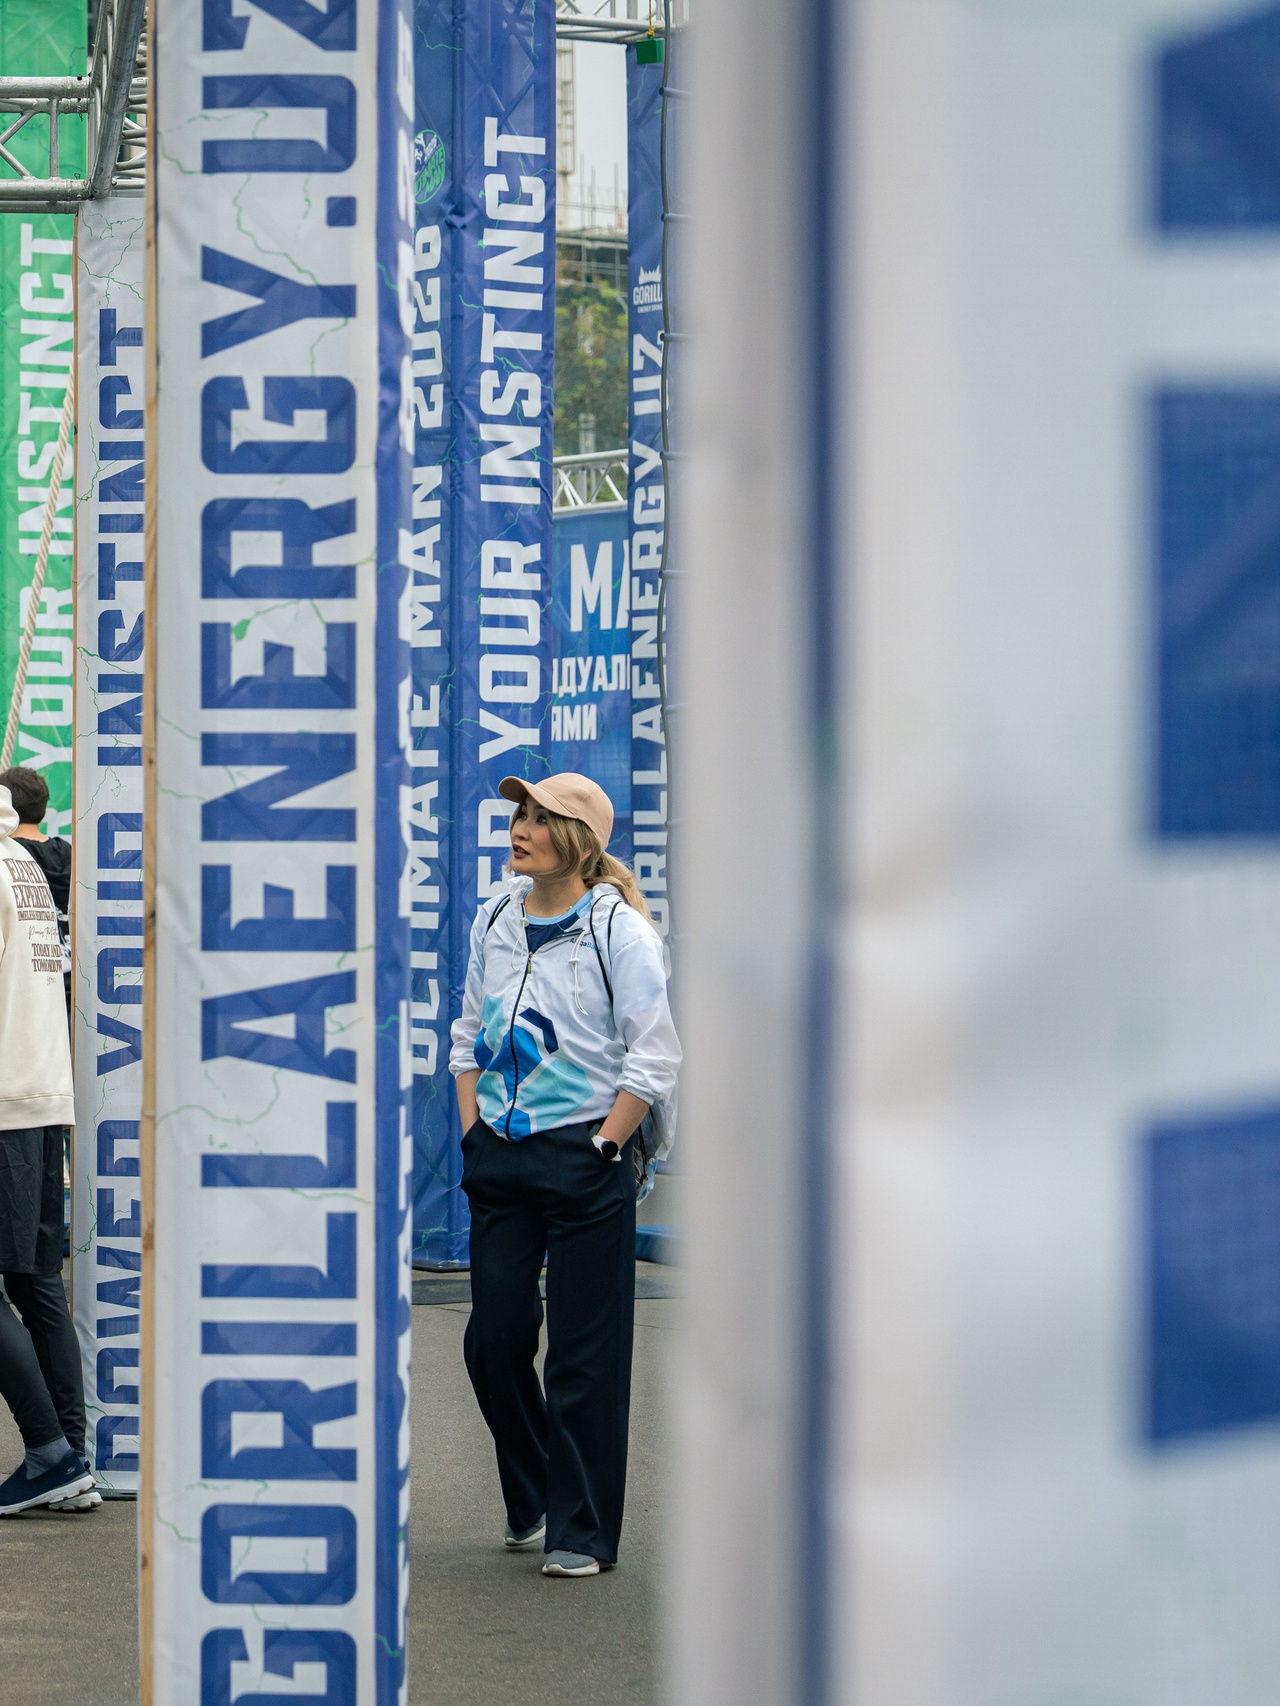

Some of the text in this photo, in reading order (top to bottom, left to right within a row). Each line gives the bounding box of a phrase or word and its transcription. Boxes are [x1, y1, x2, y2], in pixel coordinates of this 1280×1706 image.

[479, 116, 546, 506] INSTINCT
[633, 283, 663, 306] GORILL
[410, 464, 443, 648] MAN
[479, 540, 542, 763] YOUR
[31, 943, 51, 957] TODAY
[31, 958, 63, 973] TOMORROW
